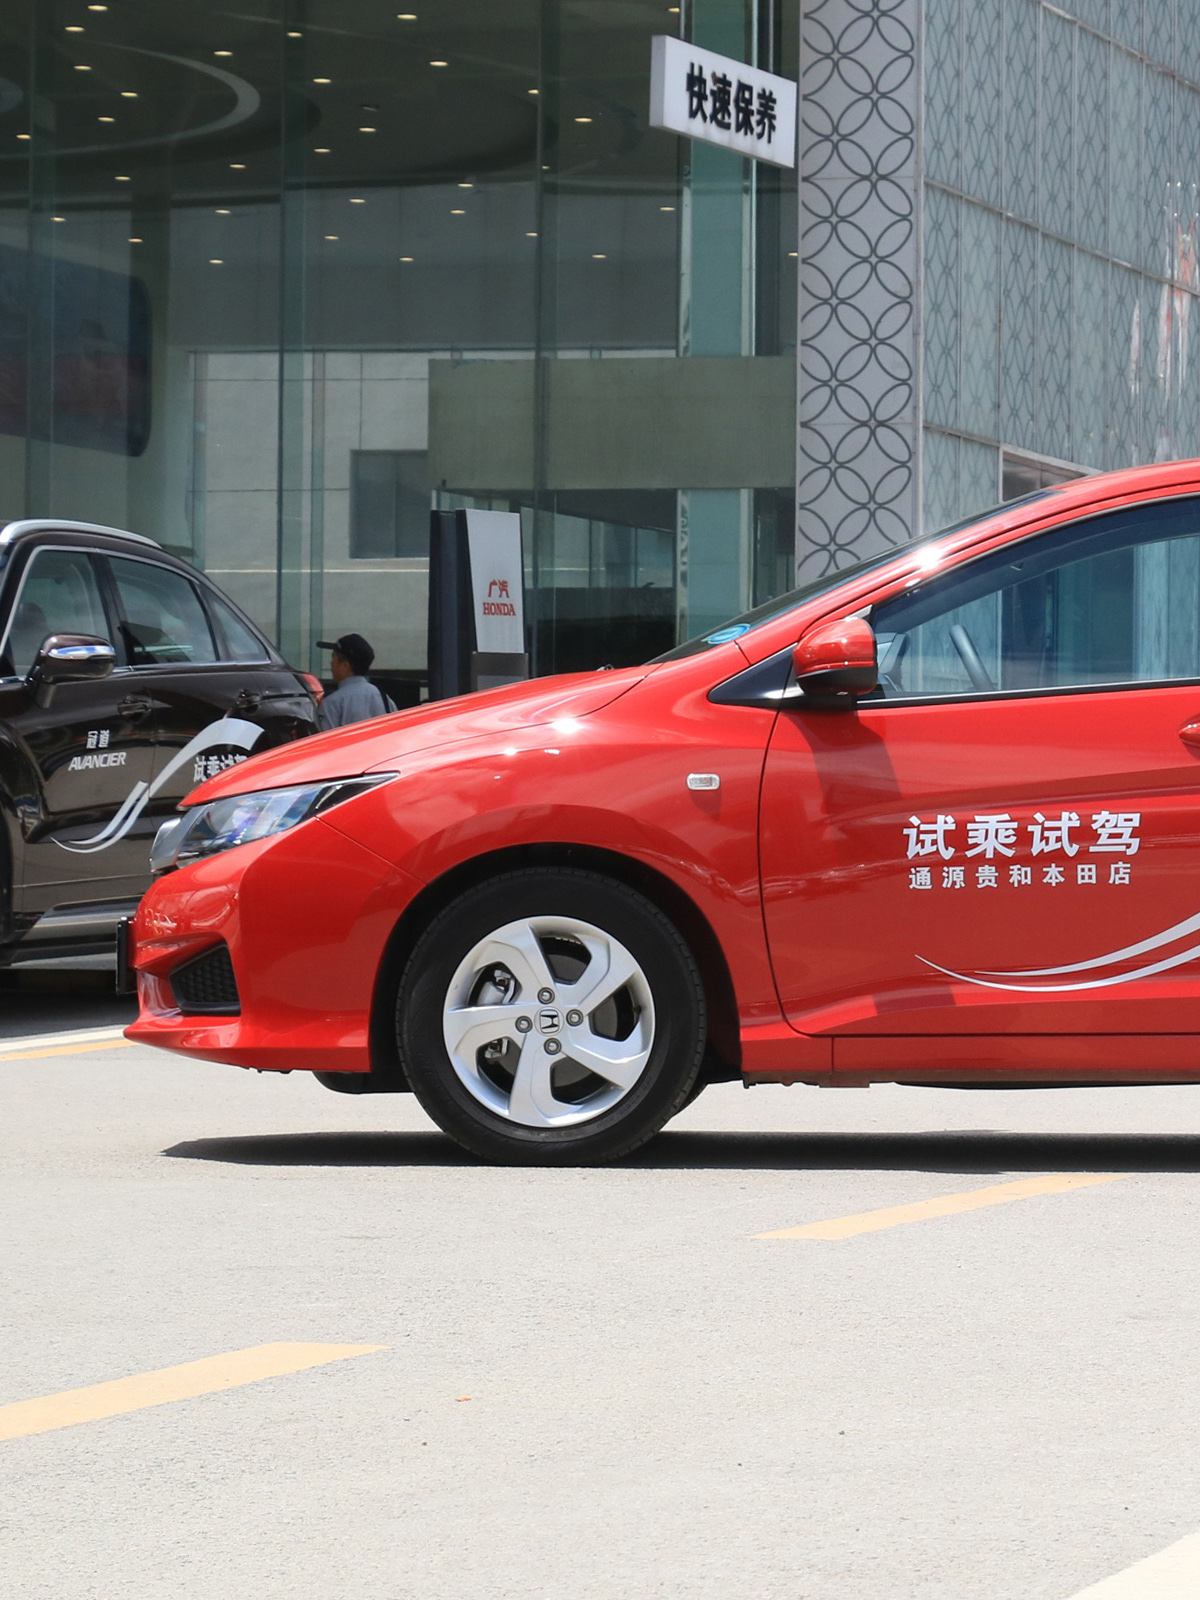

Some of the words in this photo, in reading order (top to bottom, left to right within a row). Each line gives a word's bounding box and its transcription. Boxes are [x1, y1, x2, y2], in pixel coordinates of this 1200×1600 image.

[686, 61, 777, 144] 快速保养
[488, 579, 509, 598] 广汽
[483, 602, 516, 616] HONDA
[68, 751, 127, 772] AVANCIER
[193, 753, 248, 783] 试乘试
[902, 810, 1141, 861] 试乘试驾
[908, 861, 1132, 890] 通源贵和本田店
